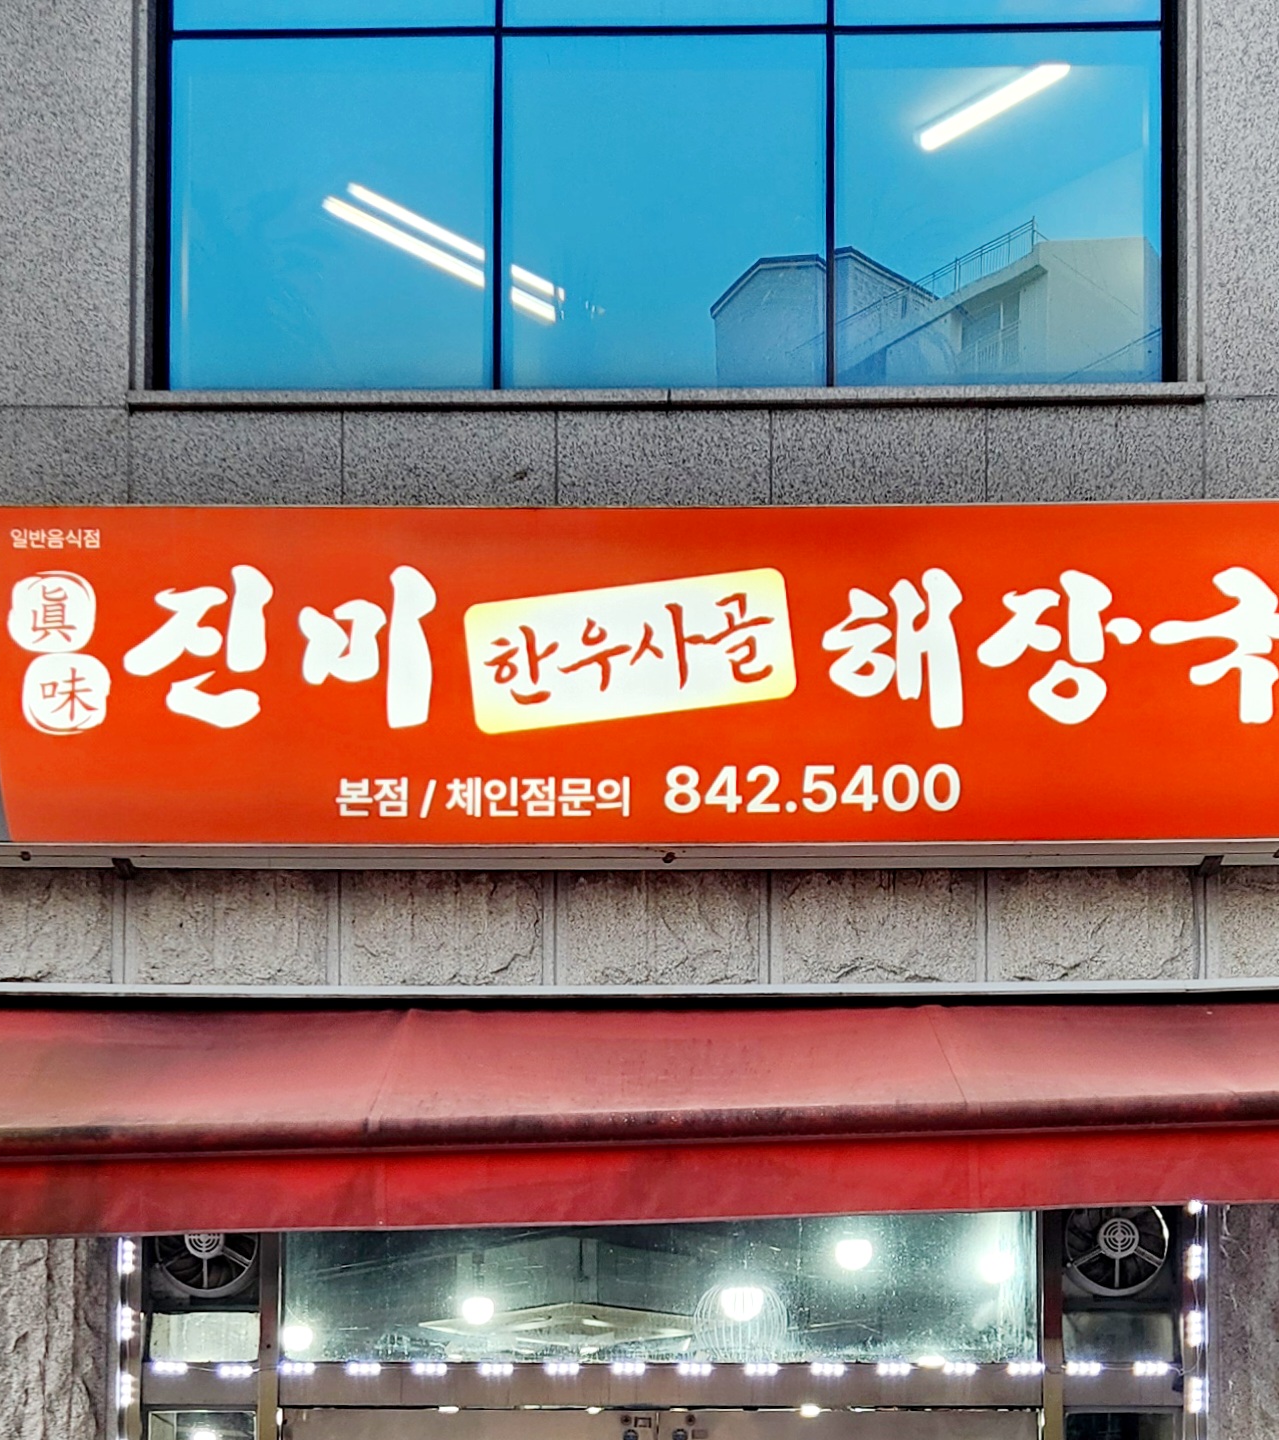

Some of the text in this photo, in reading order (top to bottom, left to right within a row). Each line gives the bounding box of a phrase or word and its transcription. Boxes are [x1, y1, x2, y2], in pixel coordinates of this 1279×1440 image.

[10, 528, 101, 549] 일반음식점
[123, 563, 438, 728] 진미
[485, 591, 775, 704] 한우사골
[336, 776, 409, 817] 본점
[446, 775, 631, 818] 체인점문의
[664, 764, 961, 814] 842.5400
